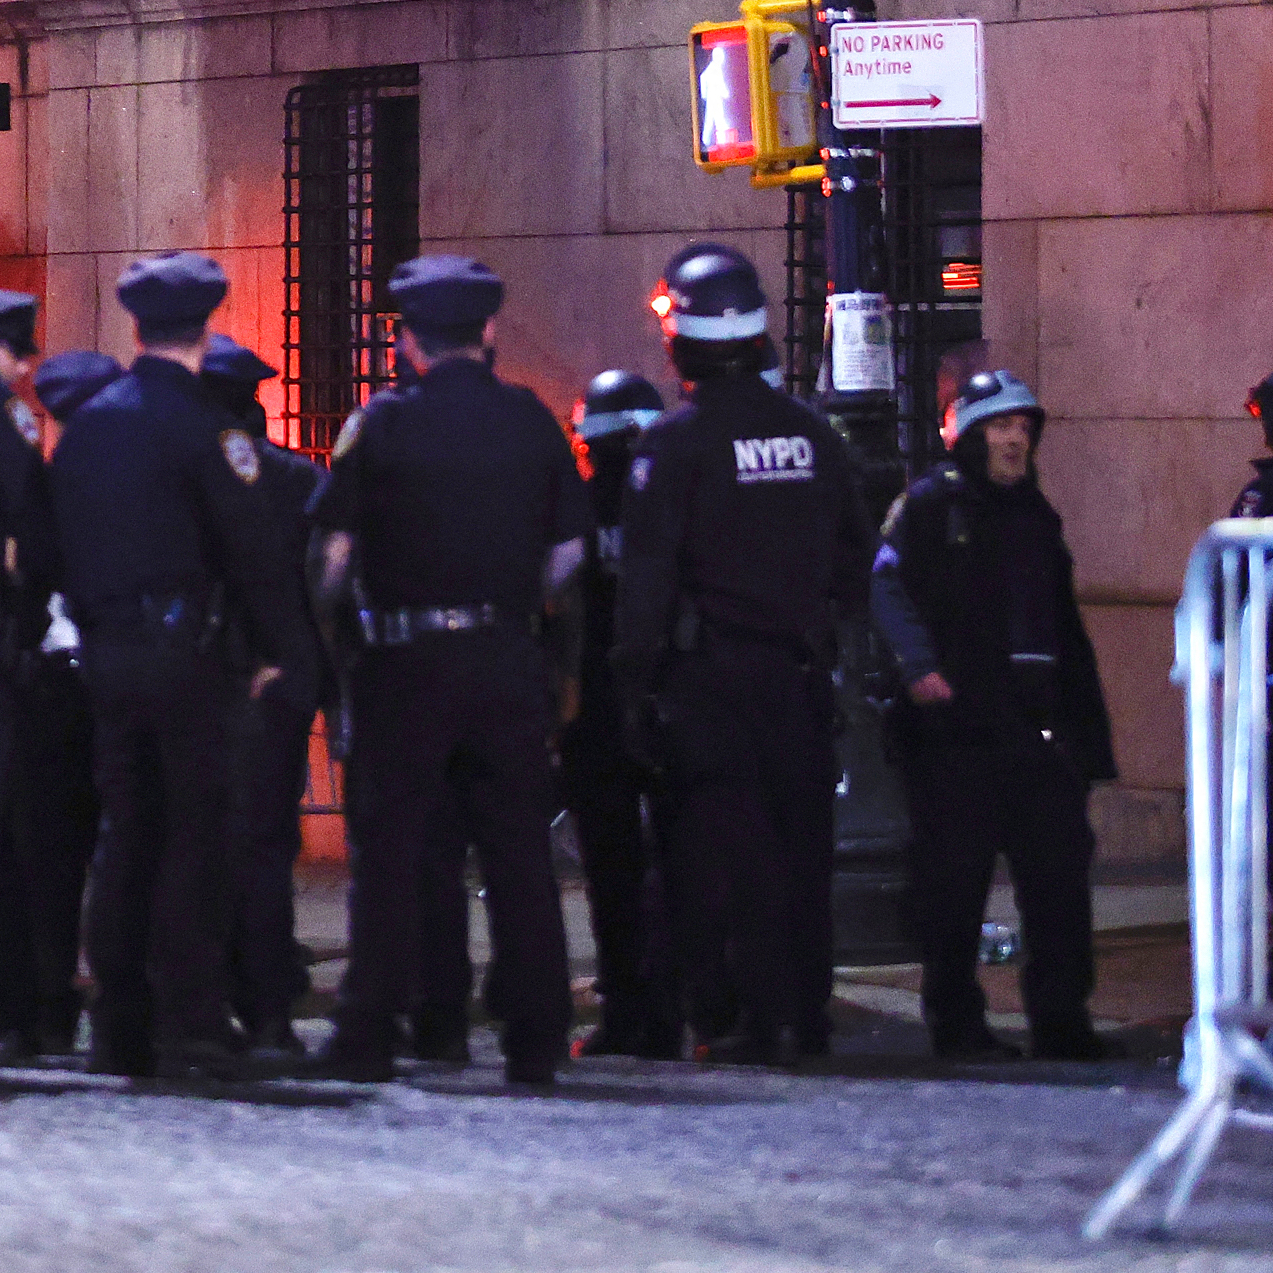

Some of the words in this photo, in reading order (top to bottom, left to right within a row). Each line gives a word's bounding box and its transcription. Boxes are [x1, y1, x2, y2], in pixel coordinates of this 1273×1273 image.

[842, 35, 864, 53] NO
[871, 33, 944, 52] PARKING
[843, 58, 912, 79] Anytime
[733, 437, 814, 470] NYPD
